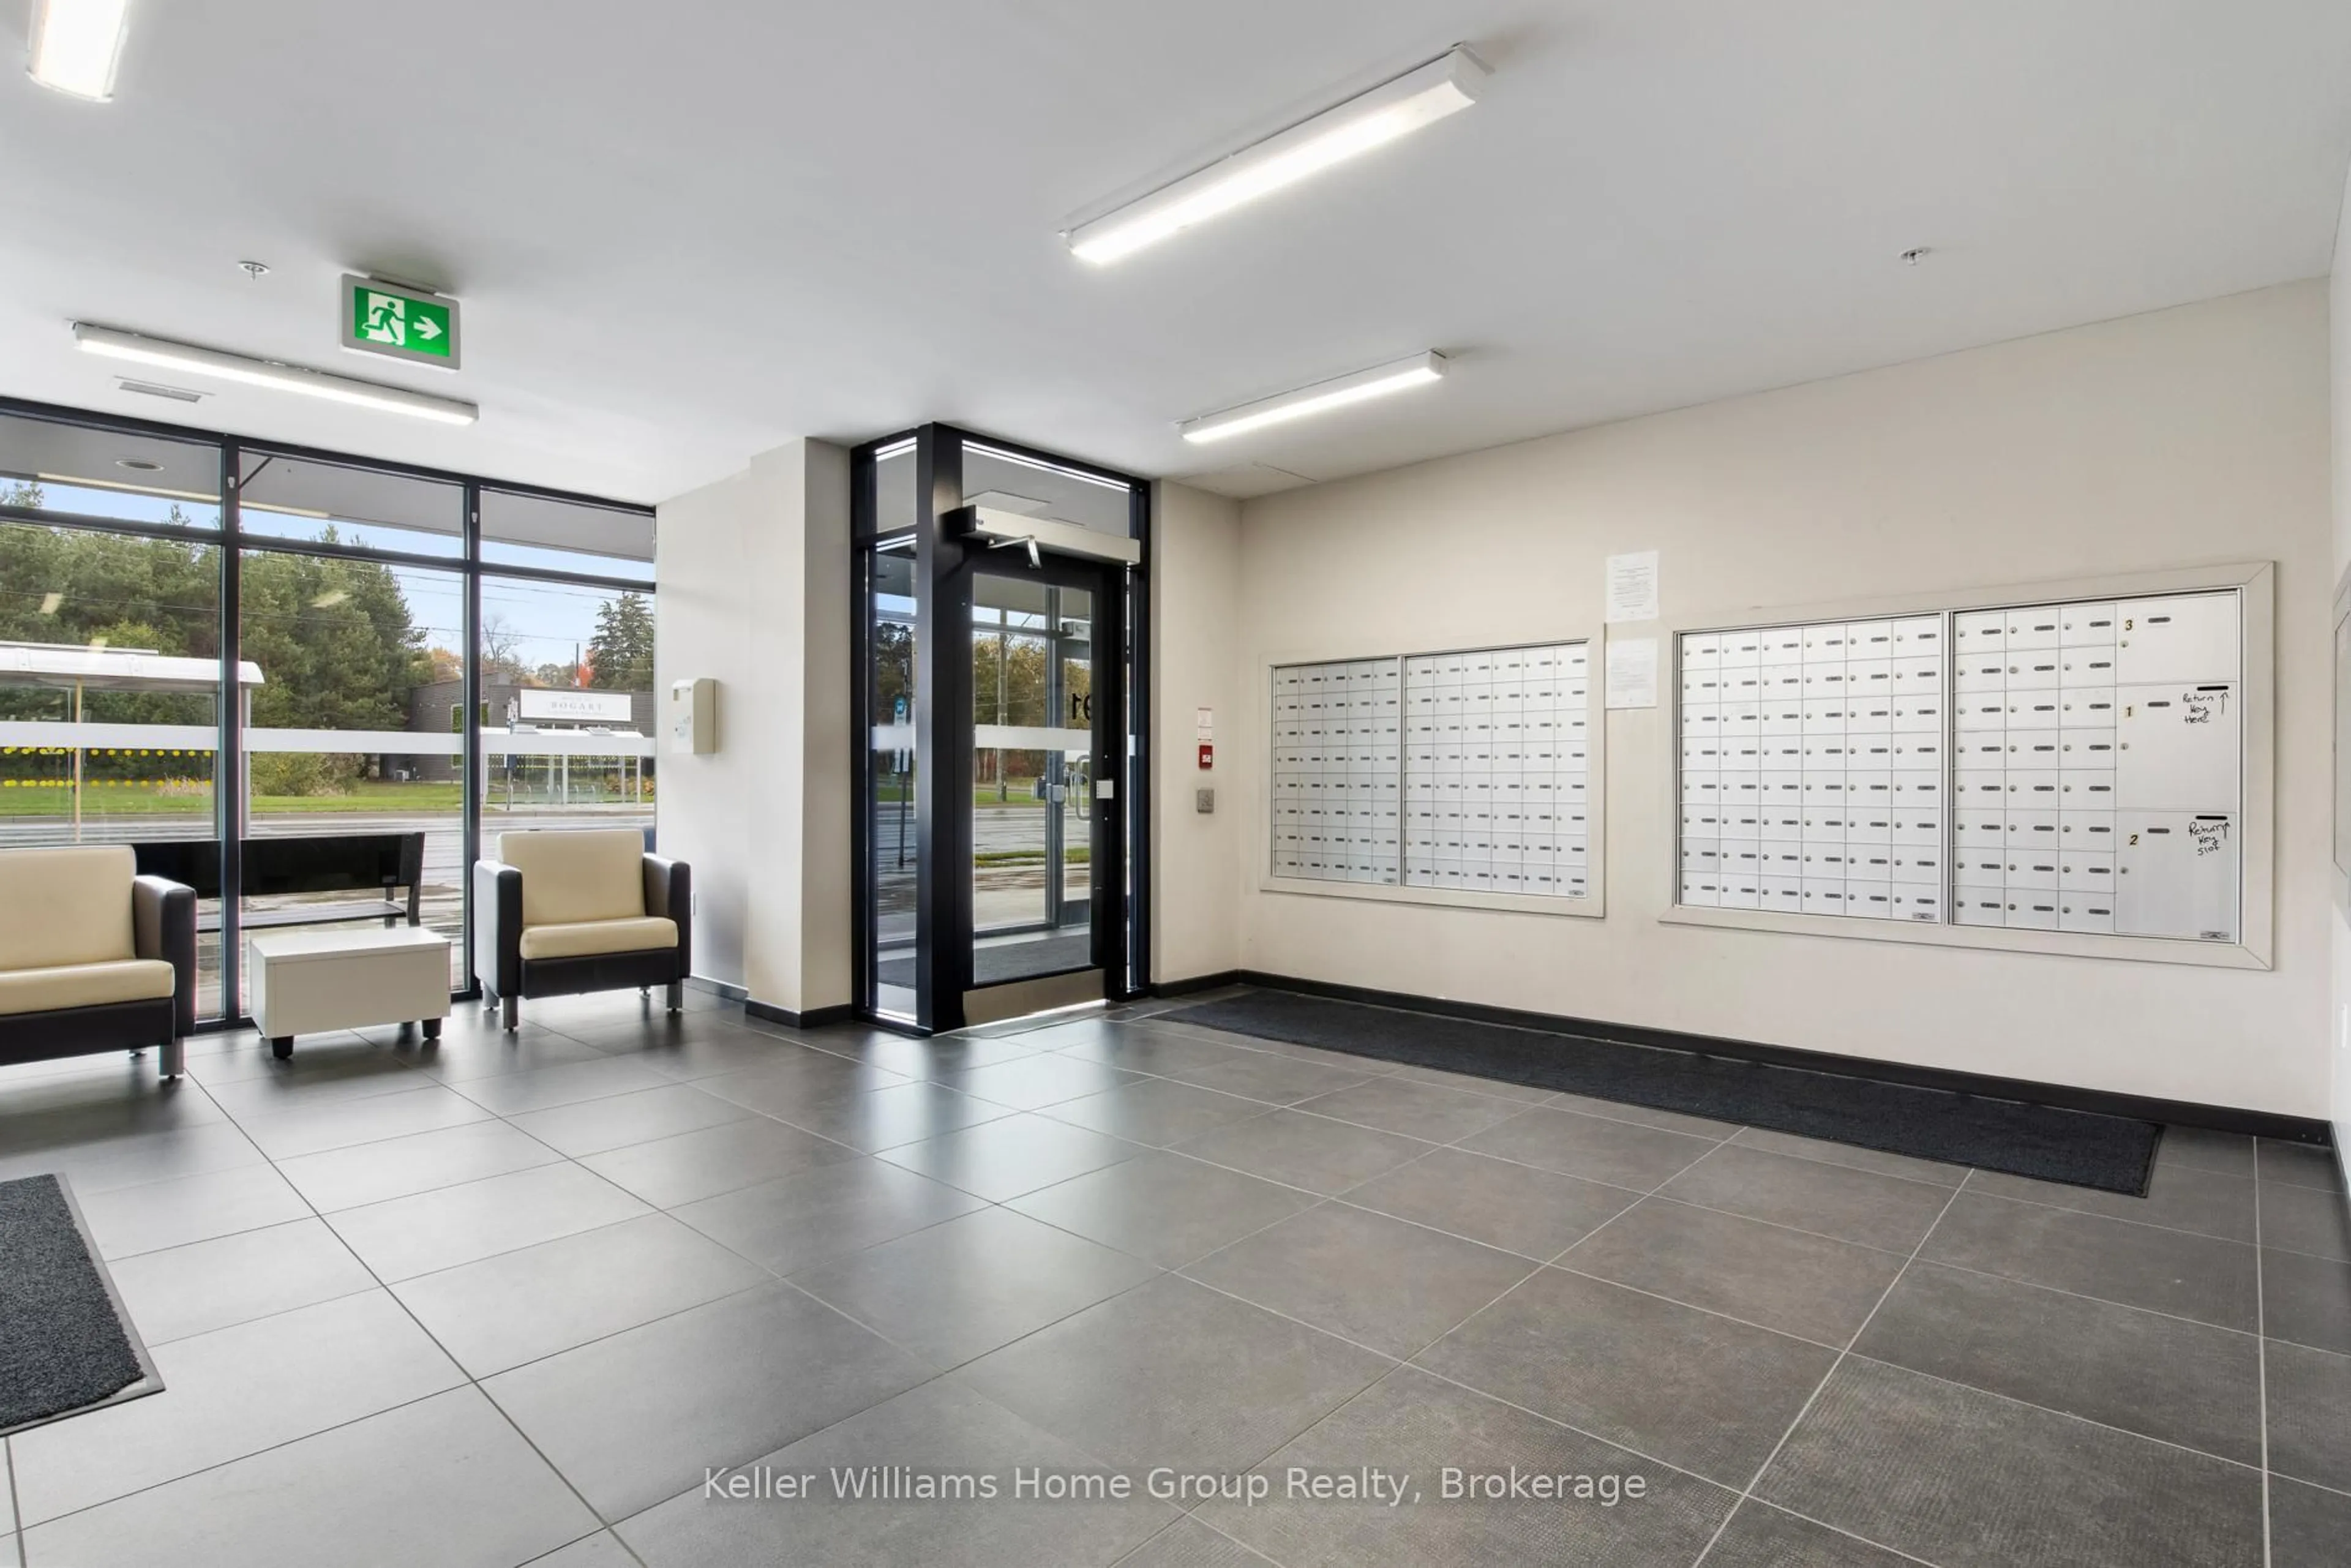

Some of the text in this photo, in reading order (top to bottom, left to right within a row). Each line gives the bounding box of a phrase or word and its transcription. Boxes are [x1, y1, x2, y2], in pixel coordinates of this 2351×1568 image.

[2125, 619, 2133, 631] 3
[2126, 706, 2132, 717] 1
[2129, 835, 2139, 846] 2
